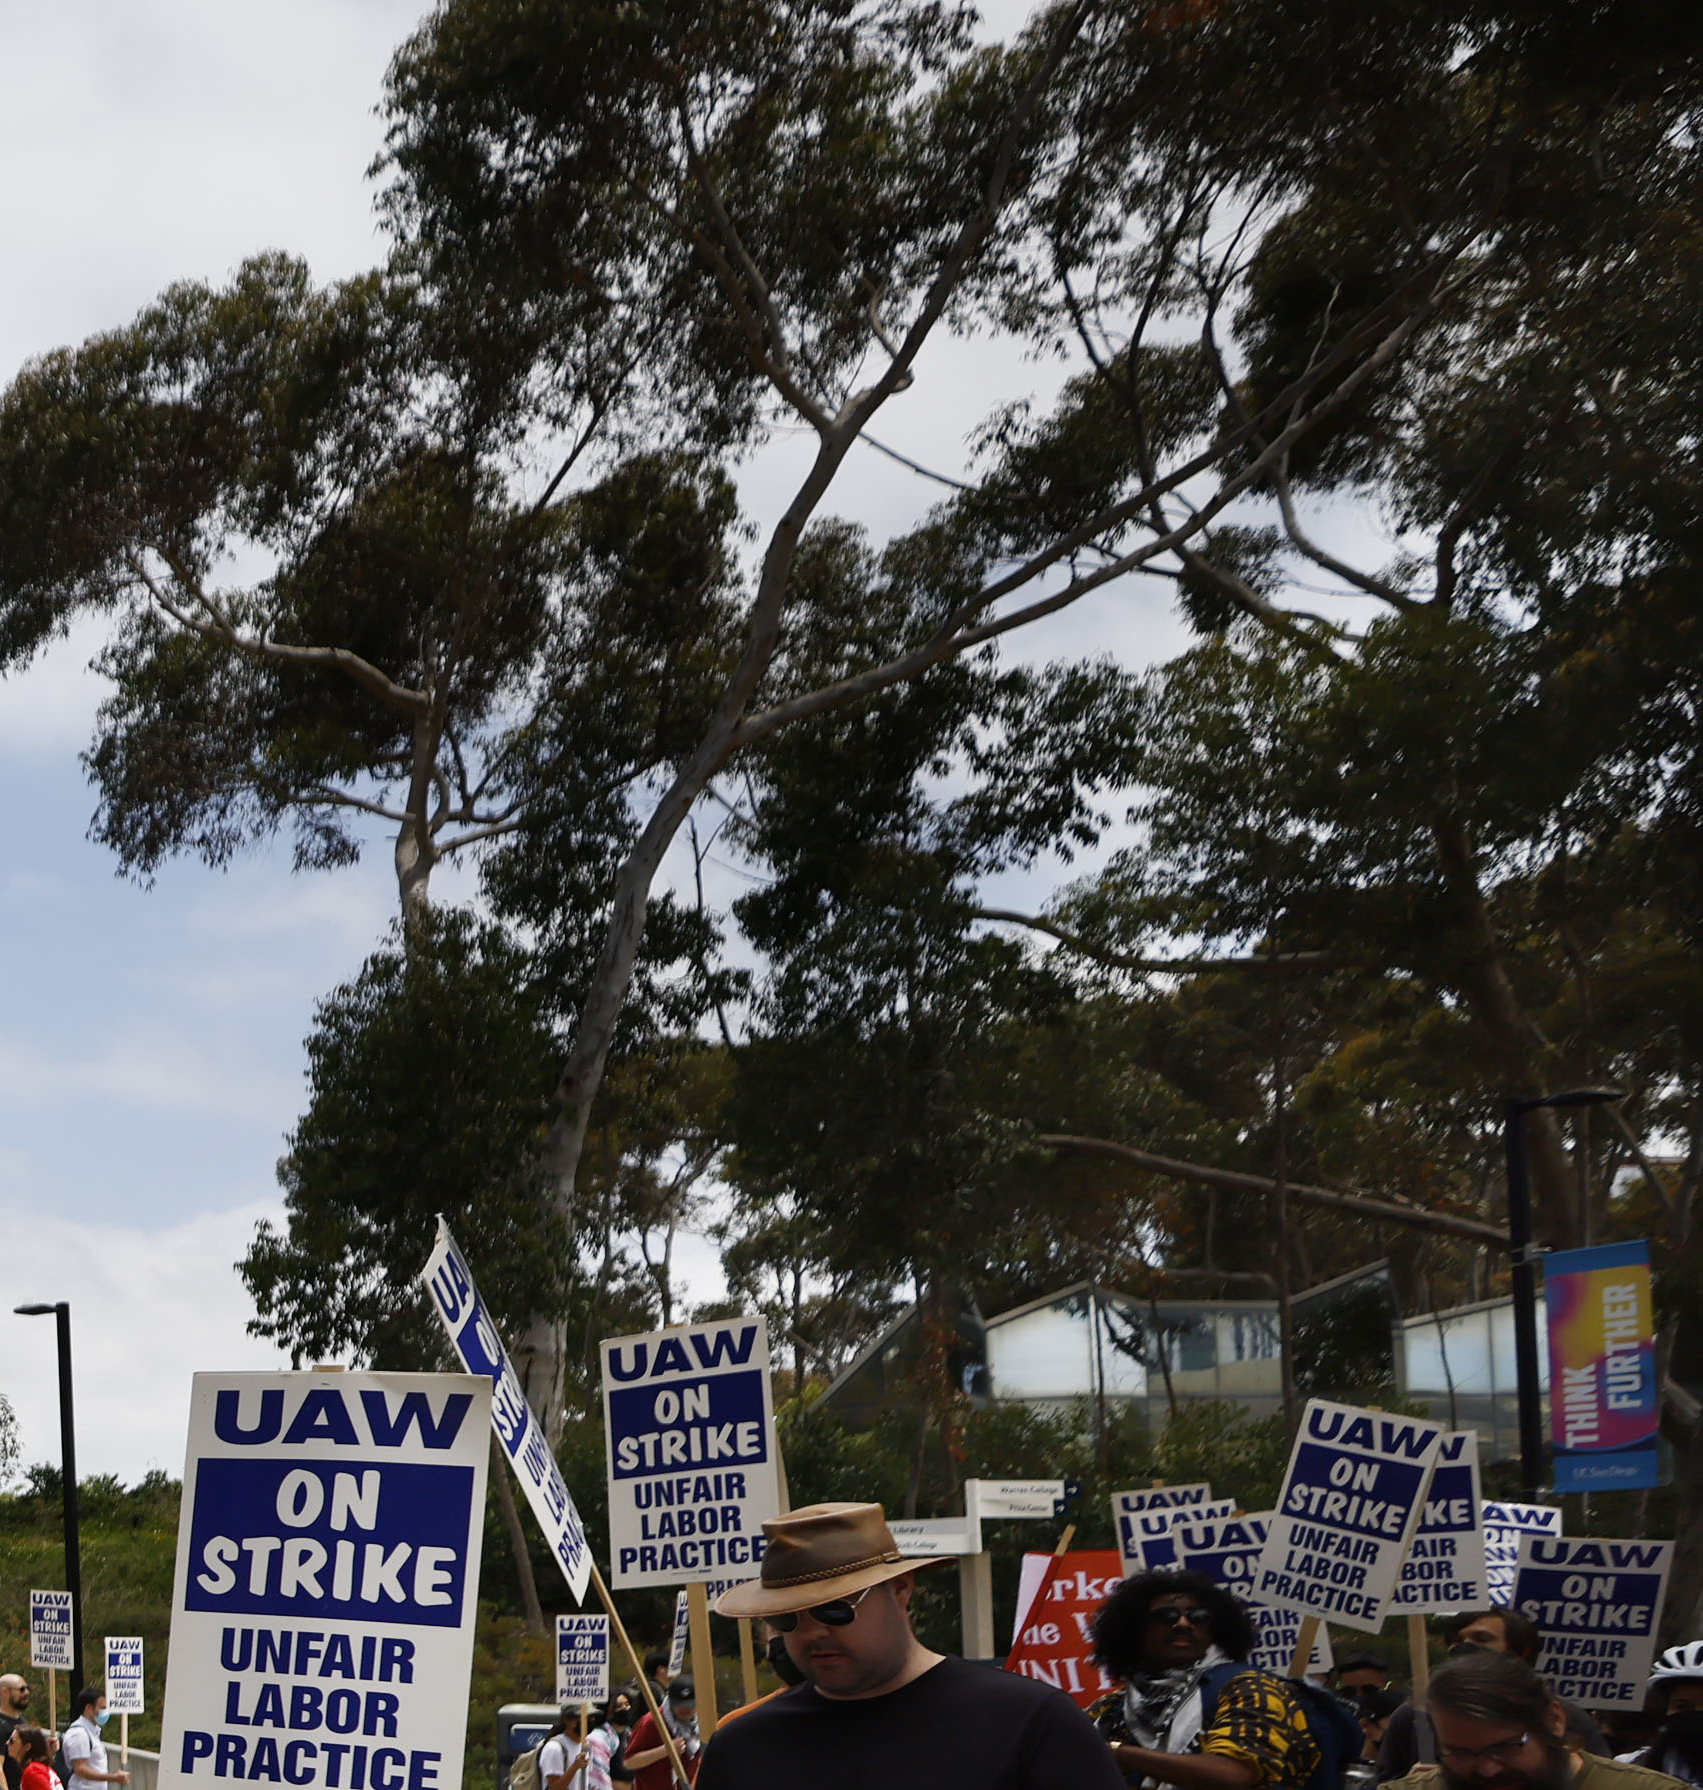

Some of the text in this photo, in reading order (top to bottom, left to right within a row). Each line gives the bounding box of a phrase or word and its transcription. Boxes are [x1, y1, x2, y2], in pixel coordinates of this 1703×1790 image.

[608, 1325, 758, 1382] UAW
[1602, 1283, 1642, 1410] FURTHER
[654, 1384, 710, 1425] ON
[1562, 1362, 1599, 1449] THINK
[214, 1389, 475, 1450] UAW
[617, 1421, 761, 1471] STRIKE
[1308, 1408, 1438, 1459] UAW
[1329, 1457, 1380, 1492] ON
[276, 1469, 381, 1531] ON
[634, 1472, 746, 1510] UNFAIR
[1121, 1486, 1204, 1512] UAW
[1141, 1506, 1230, 1536] UAW
[1287, 1483, 1406, 1534] STRIKE
[1482, 1505, 1555, 1527] AW
[641, 1505, 741, 1541] LABOR
[620, 1535, 768, 1574] PRACTICE
[1290, 1524, 1379, 1565] UNFAIR
[1530, 1541, 1664, 1568] UAW
[197, 1535, 457, 1606] STRIKE
[1285, 1550, 1368, 1589] LABOR
[33, 1593, 69, 1605] UAW
[1261, 1570, 1381, 1620] PRACTICE
[1561, 1574, 1617, 1601] ON
[34, 1621, 69, 1633] STRIKE
[43, 1609, 58, 1620] ON
[560, 1619, 606, 1631] UAW
[1521, 1600, 1650, 1628] STRIKE
[38, 1636, 65, 1645] UNFAIR
[39, 1645, 65, 1654] LABOR
[110, 1640, 139, 1650] UAW
[574, 1635, 592, 1648] ON
[1543, 1637, 1627, 1658] NFAIR
[34, 1654, 71, 1665] PRACTICE
[119, 1653, 132, 1664] ON
[221, 1627, 415, 1684] UNFAIR
[561, 1650, 606, 1663] STRIKE
[1544, 1658, 1618, 1679] ABOR
[110, 1665, 141, 1676] STRIKE
[566, 1666, 600, 1675] UNFAIR
[568, 1677, 599, 1686] LABOR
[114, 1681, 137, 1689] UNFAIR
[115, 1690, 136, 1698] LABOR
[560, 1687, 606, 1697] PRACTICE
[110, 1700, 141, 1708] PRACTICE
[225, 1681, 399, 1738] LABOR
